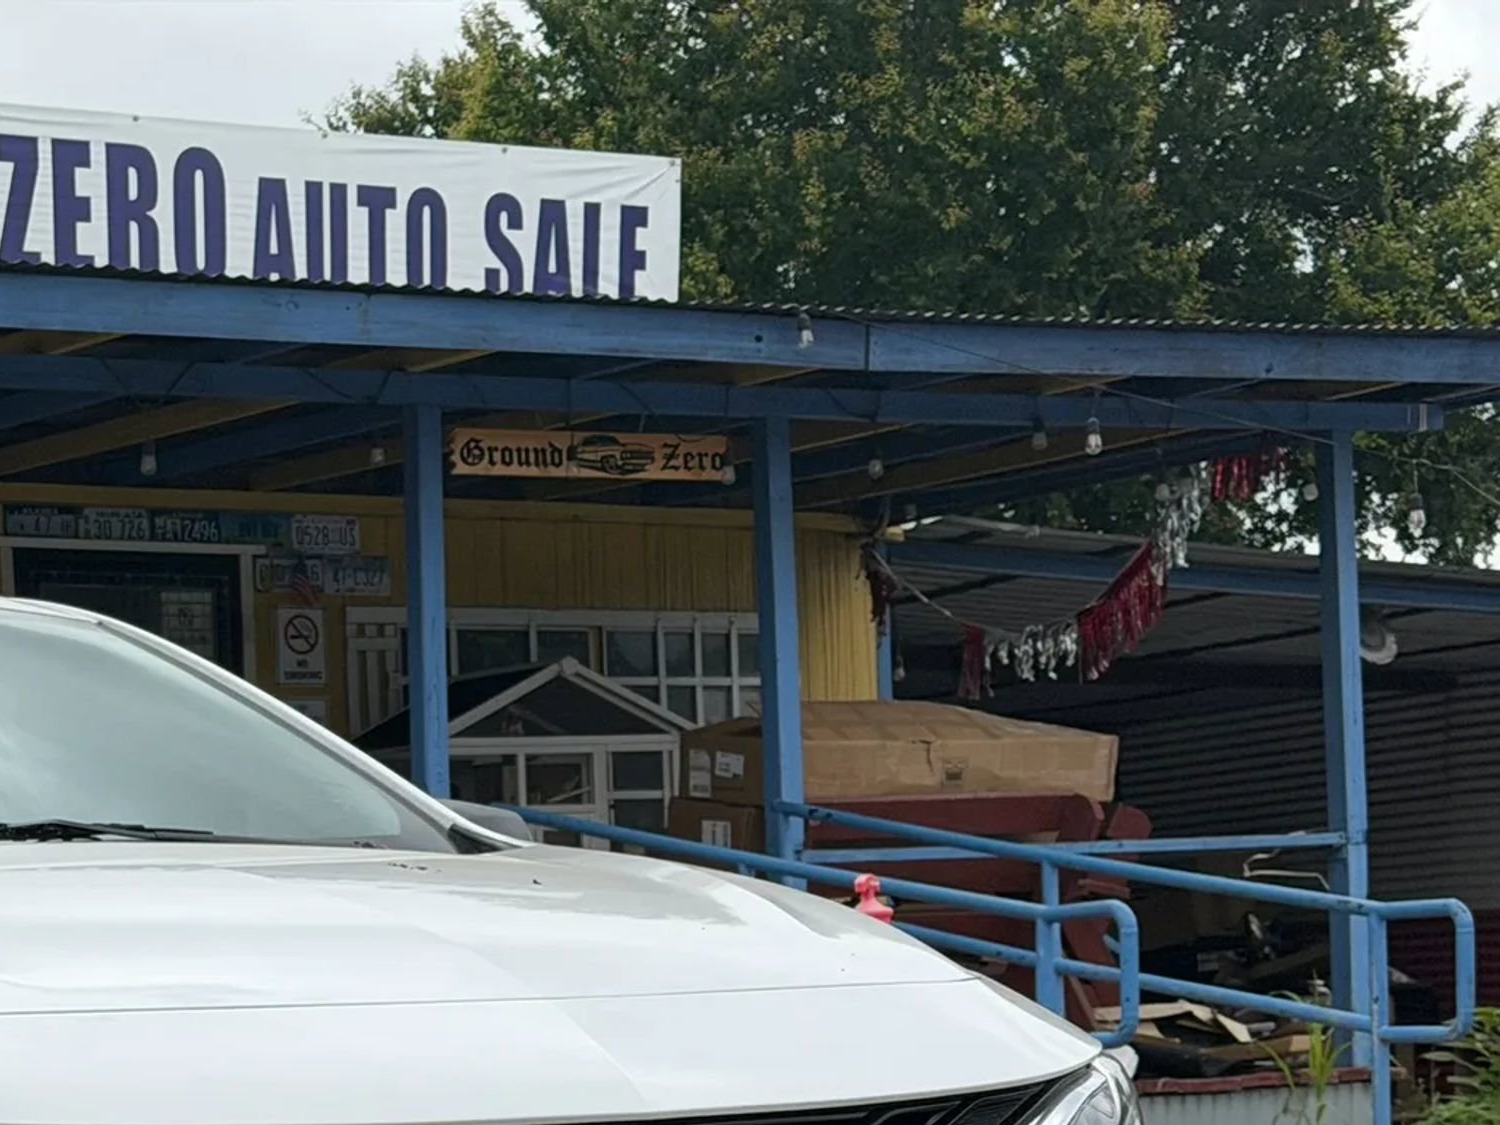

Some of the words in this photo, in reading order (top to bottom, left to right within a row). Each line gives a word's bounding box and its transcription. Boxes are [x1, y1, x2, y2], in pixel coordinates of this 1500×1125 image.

[253, 176, 448, 288] AUTO
[484, 192, 649, 301] SALE
[460, 437, 565, 468] Ground
[660, 442, 725, 472] Zero
